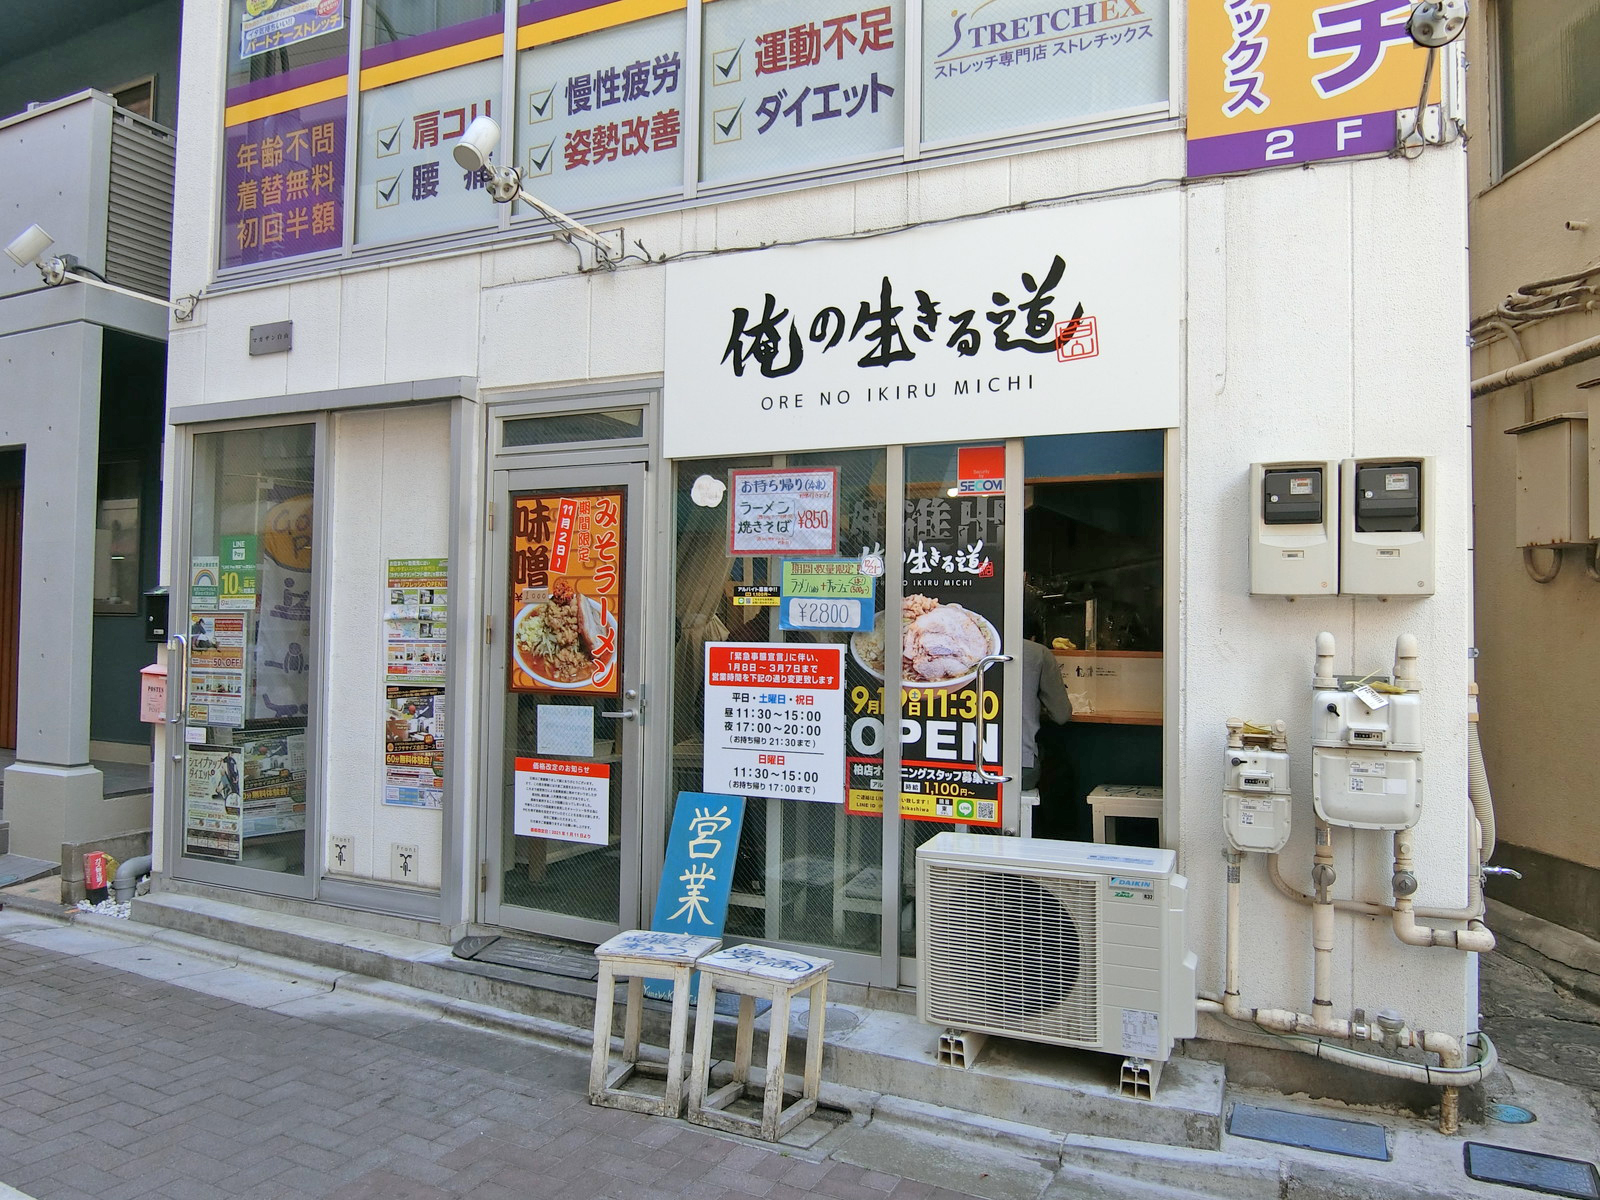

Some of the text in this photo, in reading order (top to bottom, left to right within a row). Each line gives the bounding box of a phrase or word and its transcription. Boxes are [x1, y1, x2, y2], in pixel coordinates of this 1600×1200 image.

[244, 13, 340, 54] パートナーストレッチ
[755, 6, 894, 77] 運動不足
[935, 25, 1154, 80] ストレッチ専門店 ストレチックス
[565, 51, 681, 115] 慢性疲労
[756, 72, 895, 135] ダイエット
[236, 122, 335, 172] 年齢不問
[565, 108, 681, 171] 姿勢改善
[236, 163, 334, 213] 着替無料
[236, 202, 335, 250] 初回半額
[720, 253, 1083, 379] 俺の生きる道
[760, 373, 1034, 411] ORE NO IKIRU MICHI
[960, 480, 1002, 492] SECOM
[737, 520, 793, 534] 焼きそば
[740, 501, 790, 516] ラーメン
[797, 510, 828, 530] ¥850
[232, 540, 246, 548] LINE
[514, 499, 551, 589] 味噌
[578, 501, 592, 562] 期間限定
[592, 497, 618, 690] みそラーメン
[712, 672, 834, 685] 営業時間を下記の通り変更致します
[724, 707, 734, 718] 昼
[732, 692, 814, 705] 平日・土曜日・祝日
[924, 688, 999, 720] 11:30
[724, 721, 734, 732] 夜
[850, 717, 998, 762] OPEN
[532, 762, 590, 774] 価格改定のお知らせ
[758, 754, 785, 766] 日曜日
[396, 845, 416, 853] Front
[666, 805, 732, 926] 営業
[1118, 879, 1151, 888] DAIKIN
